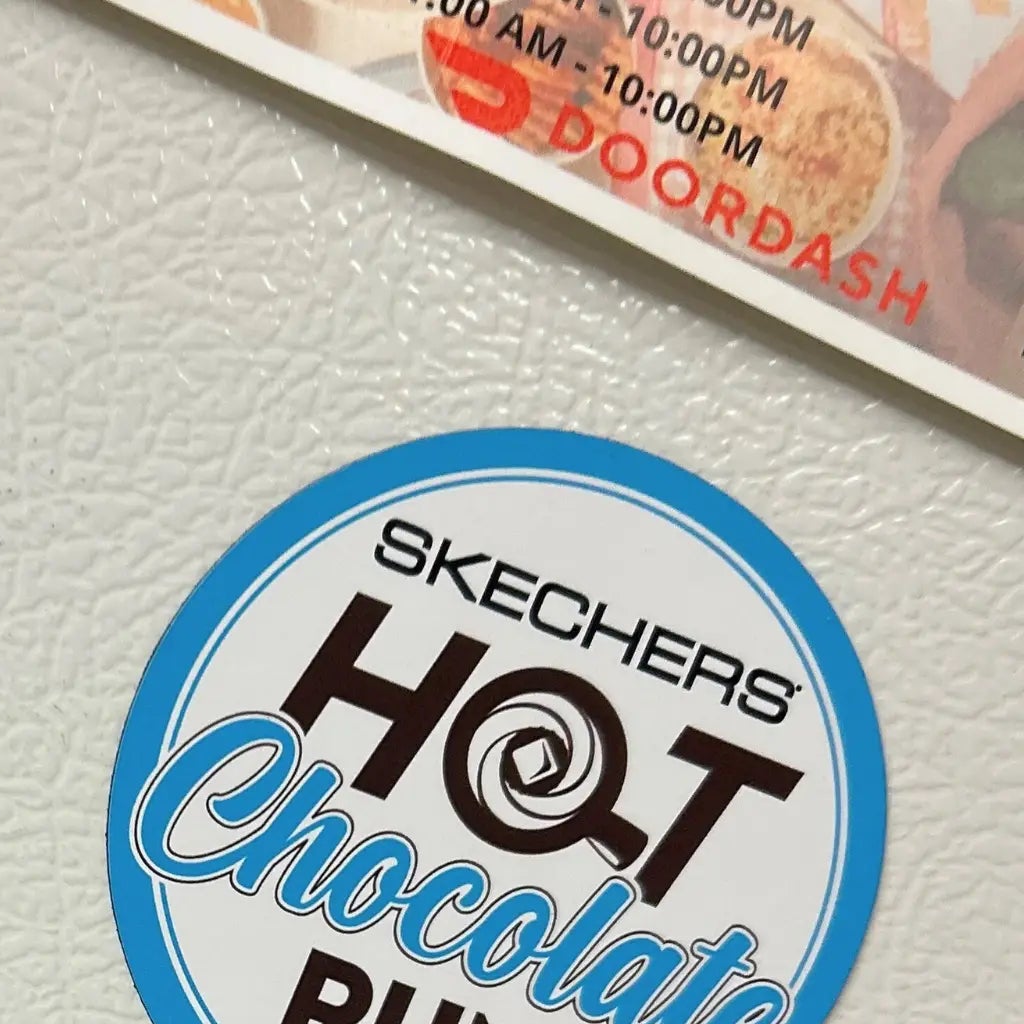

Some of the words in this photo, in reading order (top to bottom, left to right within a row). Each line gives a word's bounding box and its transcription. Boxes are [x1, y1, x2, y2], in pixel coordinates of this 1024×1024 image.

[495, 12, 567, 68] AM
[602, 63, 763, 168] 10:00PM
[626, 6, 788, 112] 10:00PM
[549, 104, 928, 326] DOORDASH
[373, 517, 803, 725] SKECHERS
[279, 591, 805, 908] HOT
